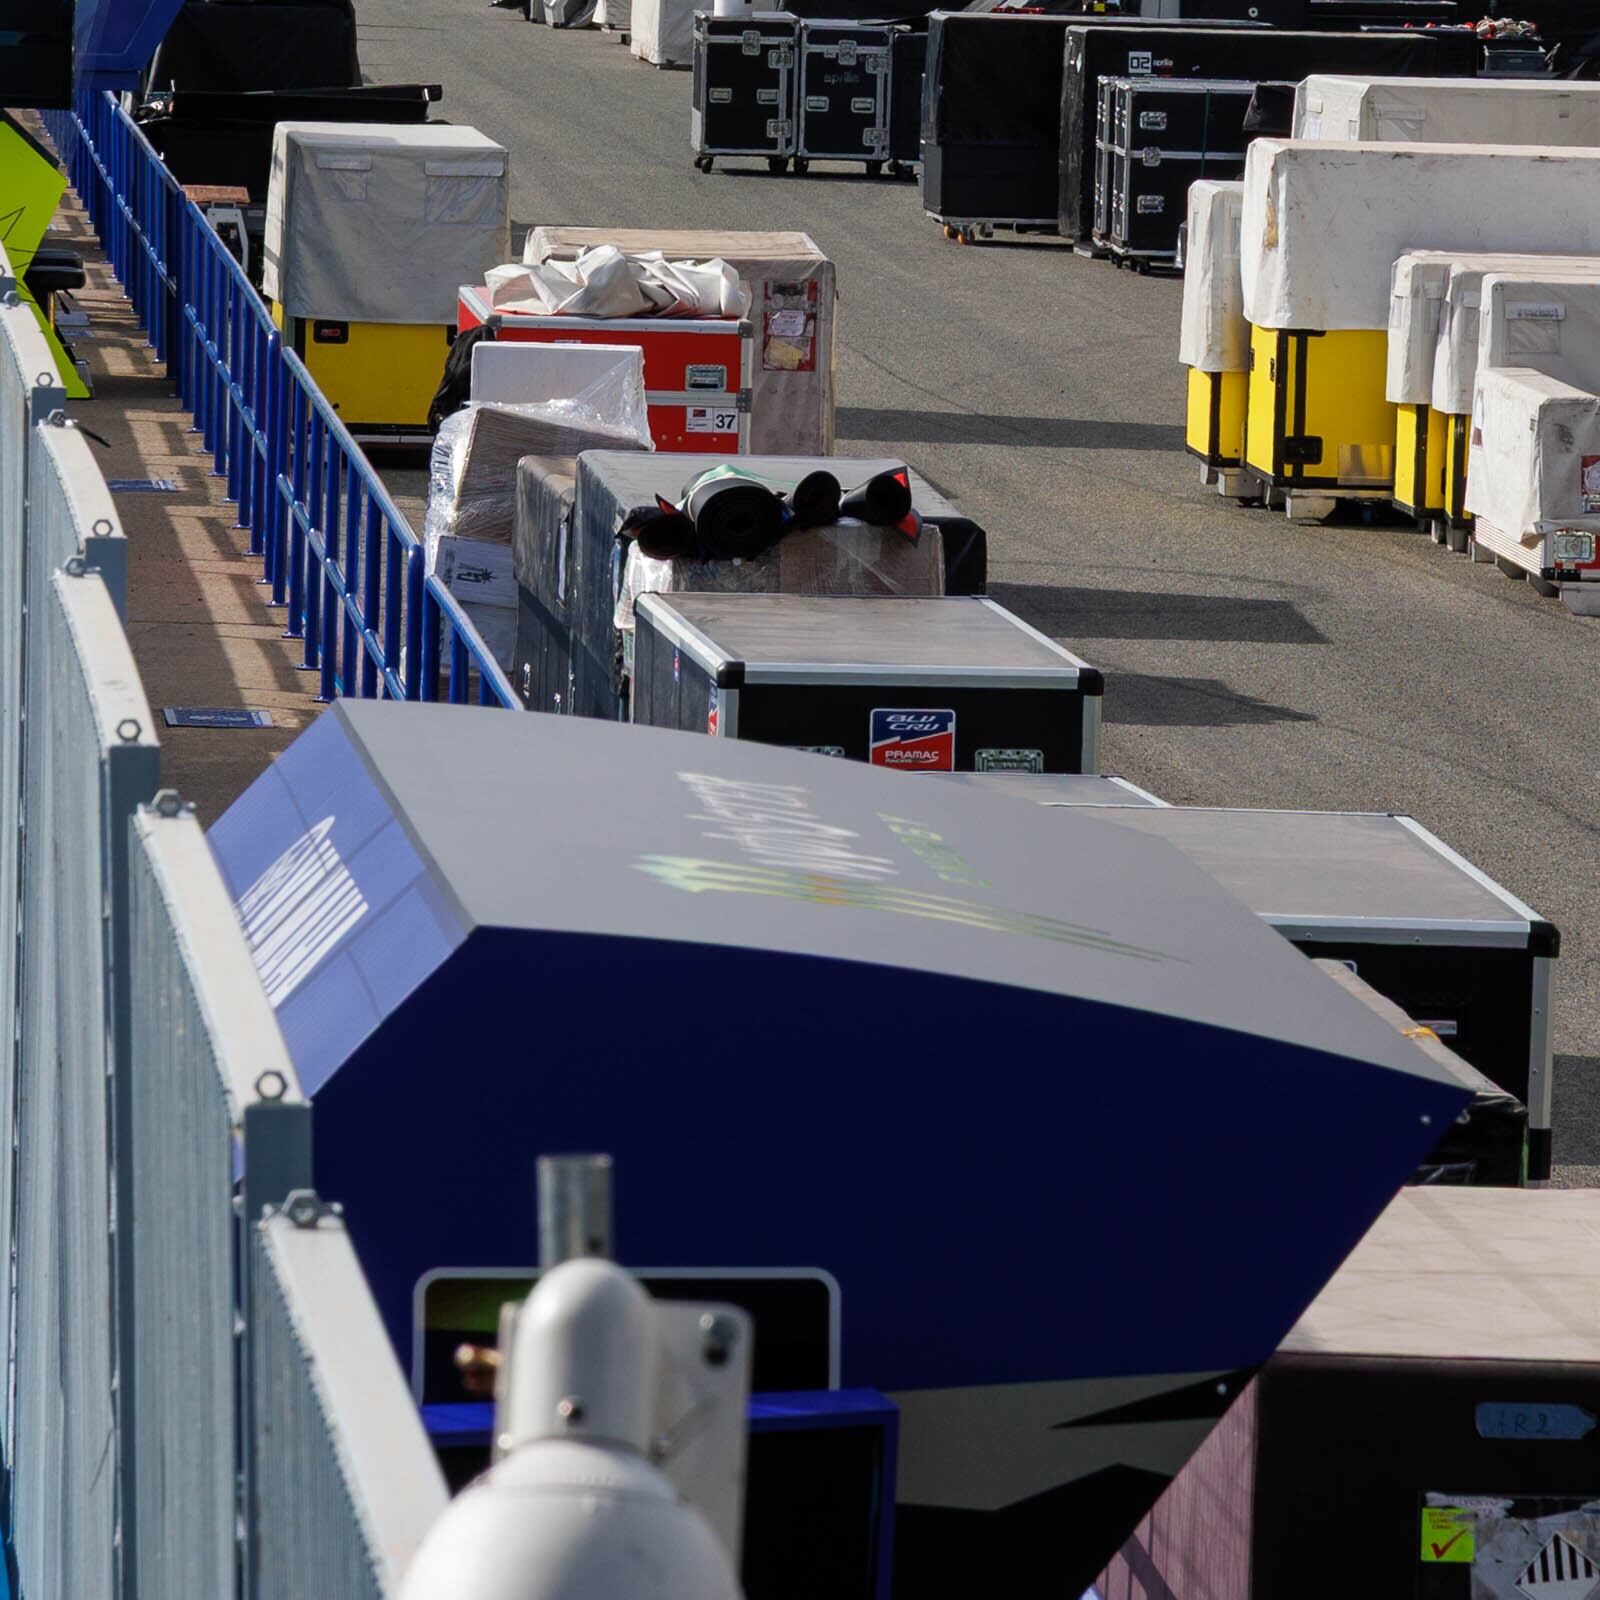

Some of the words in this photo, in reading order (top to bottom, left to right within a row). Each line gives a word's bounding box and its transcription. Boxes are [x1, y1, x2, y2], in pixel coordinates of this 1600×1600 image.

[1130, 56, 1150, 69] 02
[715, 414, 736, 429] 37
[885, 714, 937, 723] BLU
[888, 723, 941, 731] CRU
[885, 750, 940, 759] PRAMAC
